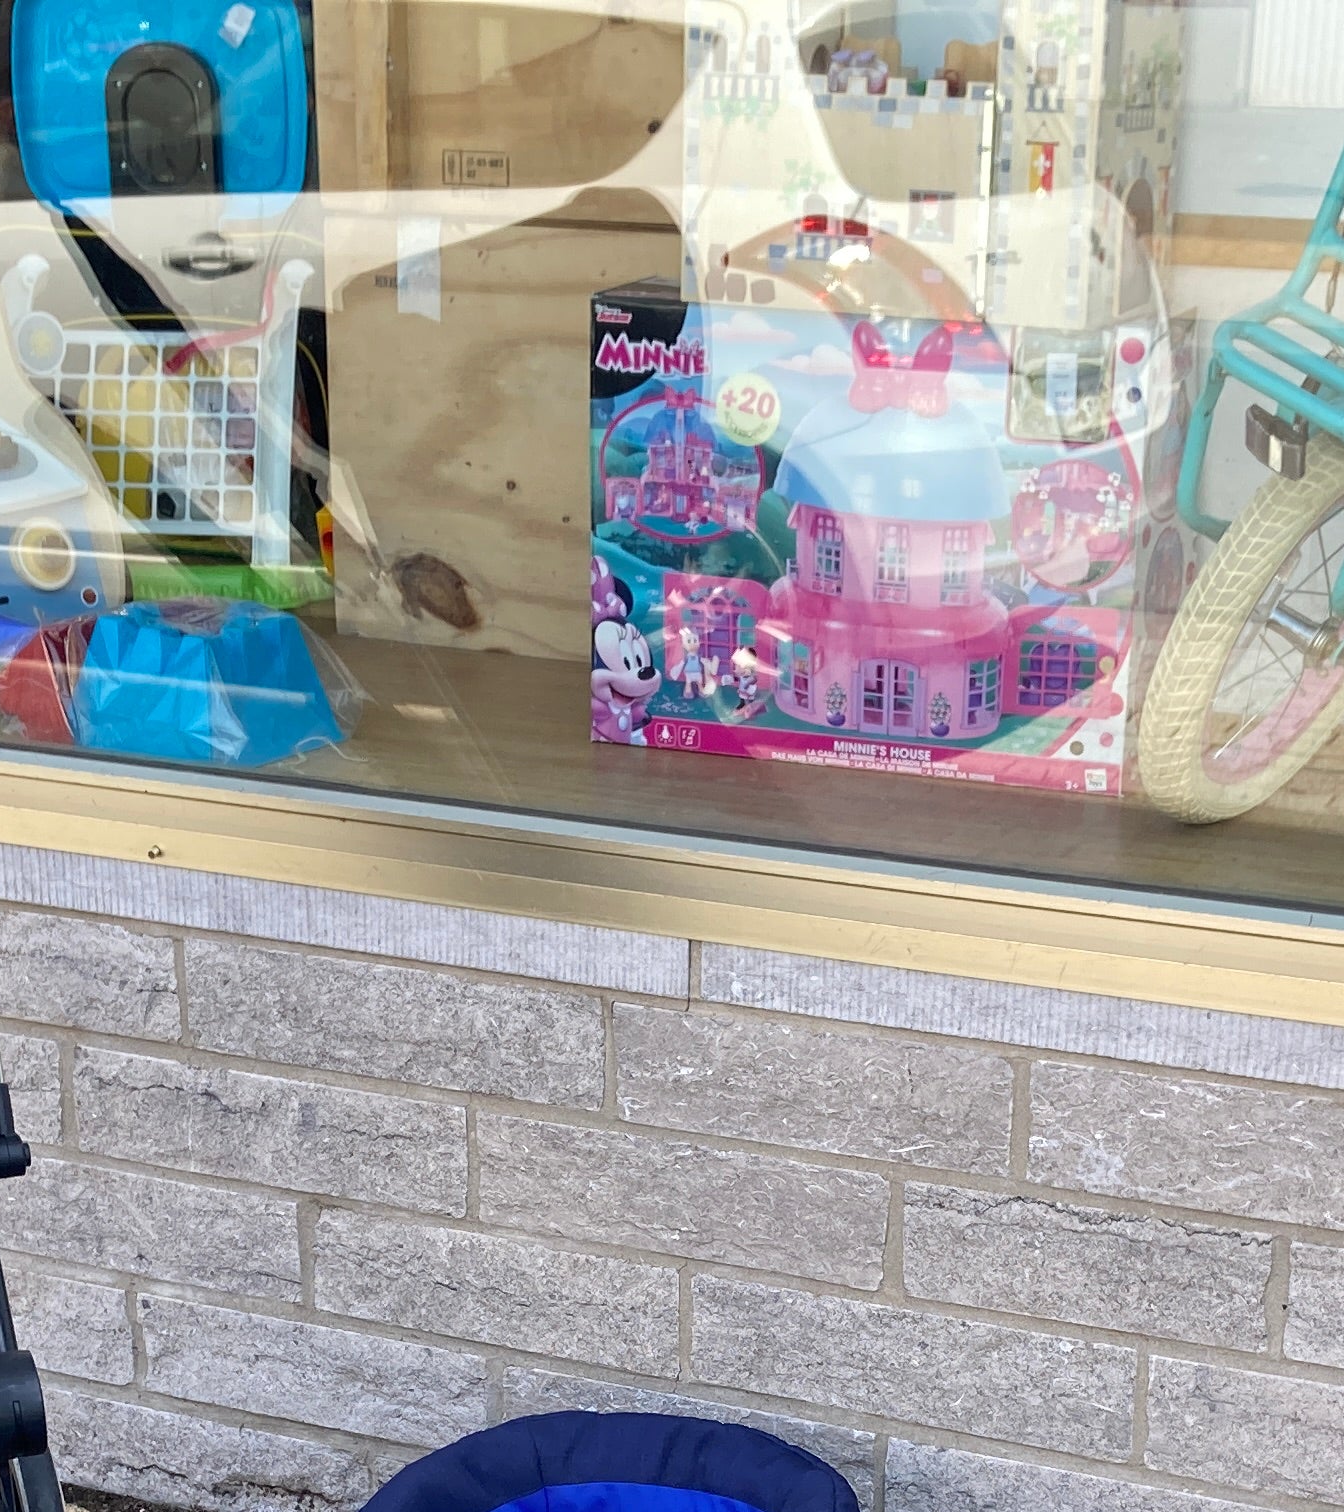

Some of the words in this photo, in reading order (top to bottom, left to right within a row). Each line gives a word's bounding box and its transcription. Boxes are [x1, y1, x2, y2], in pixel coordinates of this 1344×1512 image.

[596, 331, 710, 376] MINNIE
[722, 387, 775, 419] +20
[834, 740, 887, 757] MINNIE'S
[889, 746, 931, 761] HOUSE
